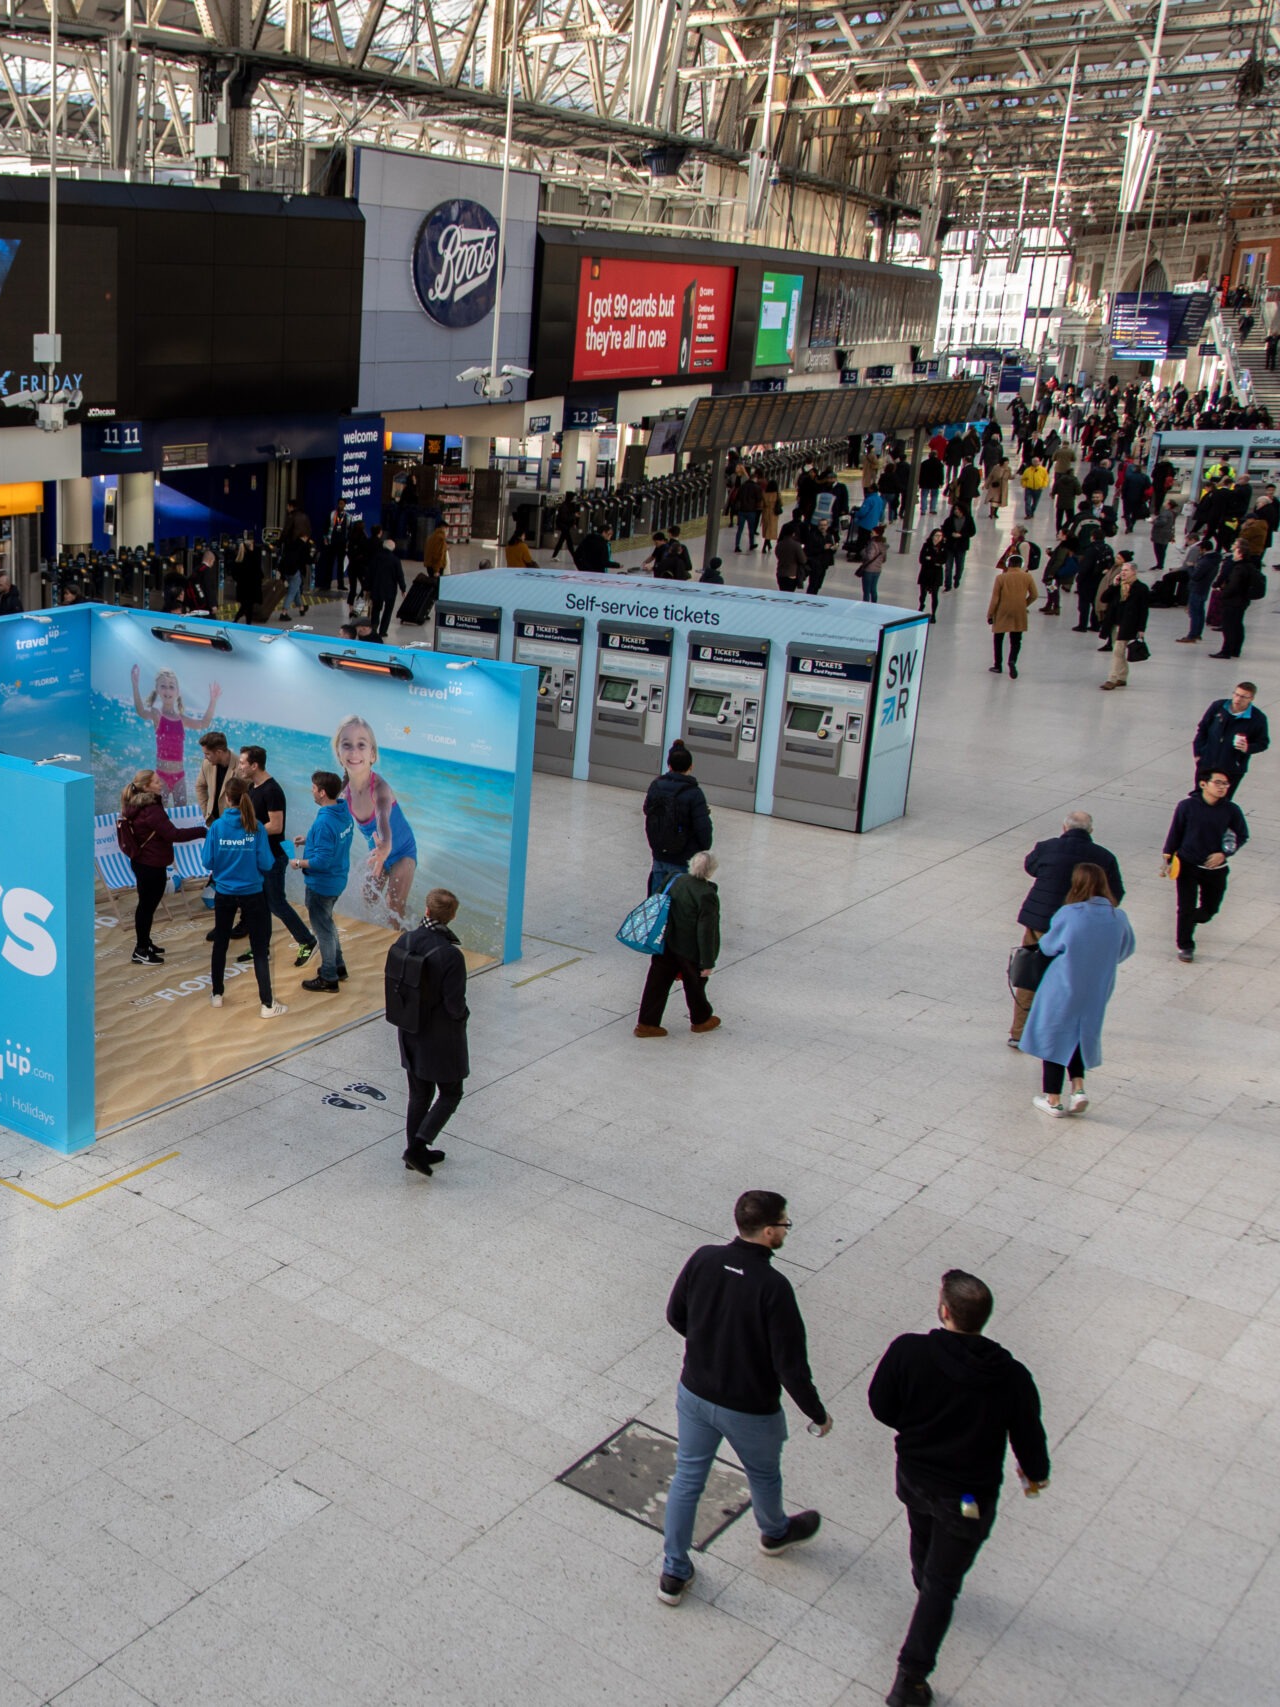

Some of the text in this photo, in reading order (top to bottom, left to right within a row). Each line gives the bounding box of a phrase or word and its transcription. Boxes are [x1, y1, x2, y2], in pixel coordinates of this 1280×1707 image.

[428, 224, 496, 302] Boots
[588, 292, 675, 324] I got 99 cards but
[586, 325, 621, 357] they're
[623, 324, 636, 349] all
[637, 324, 646, 348] in
[916, 363, 926, 372] 17
[928, 362, 937, 370] 18
[845, 372, 856, 381] 15
[881, 368, 891, 377] 16
[769, 382, 782, 391] 14
[573, 411, 588, 423] 12
[104, 428, 120, 444] 11
[124, 427, 140, 444] 11
[343, 429, 378, 444] welcome
[343, 451, 367, 462] pharmacy
[342, 464, 359, 473] beauty
[342, 475, 354, 486] food
[359, 474, 371, 484] drink
[342, 488, 354, 499] baby
[359, 486, 371, 496] child
[566, 593, 720, 626] Self-service tickets
[457, 615, 478, 624] TICKETS
[536, 625, 558, 634] TICKETS
[622, 636, 646, 645] TICKETS
[714, 648, 740, 657] TICKETS
[742, 659, 763, 667] Payments
[815, 661, 843, 670] TICKETS
[824, 669, 847, 678] Payments
[886, 648, 918, 690] SW
[896, 687, 909, 722] R
[154, 961, 255, 1002] FLORDA
[12, 1096, 55, 1126] Holidays
